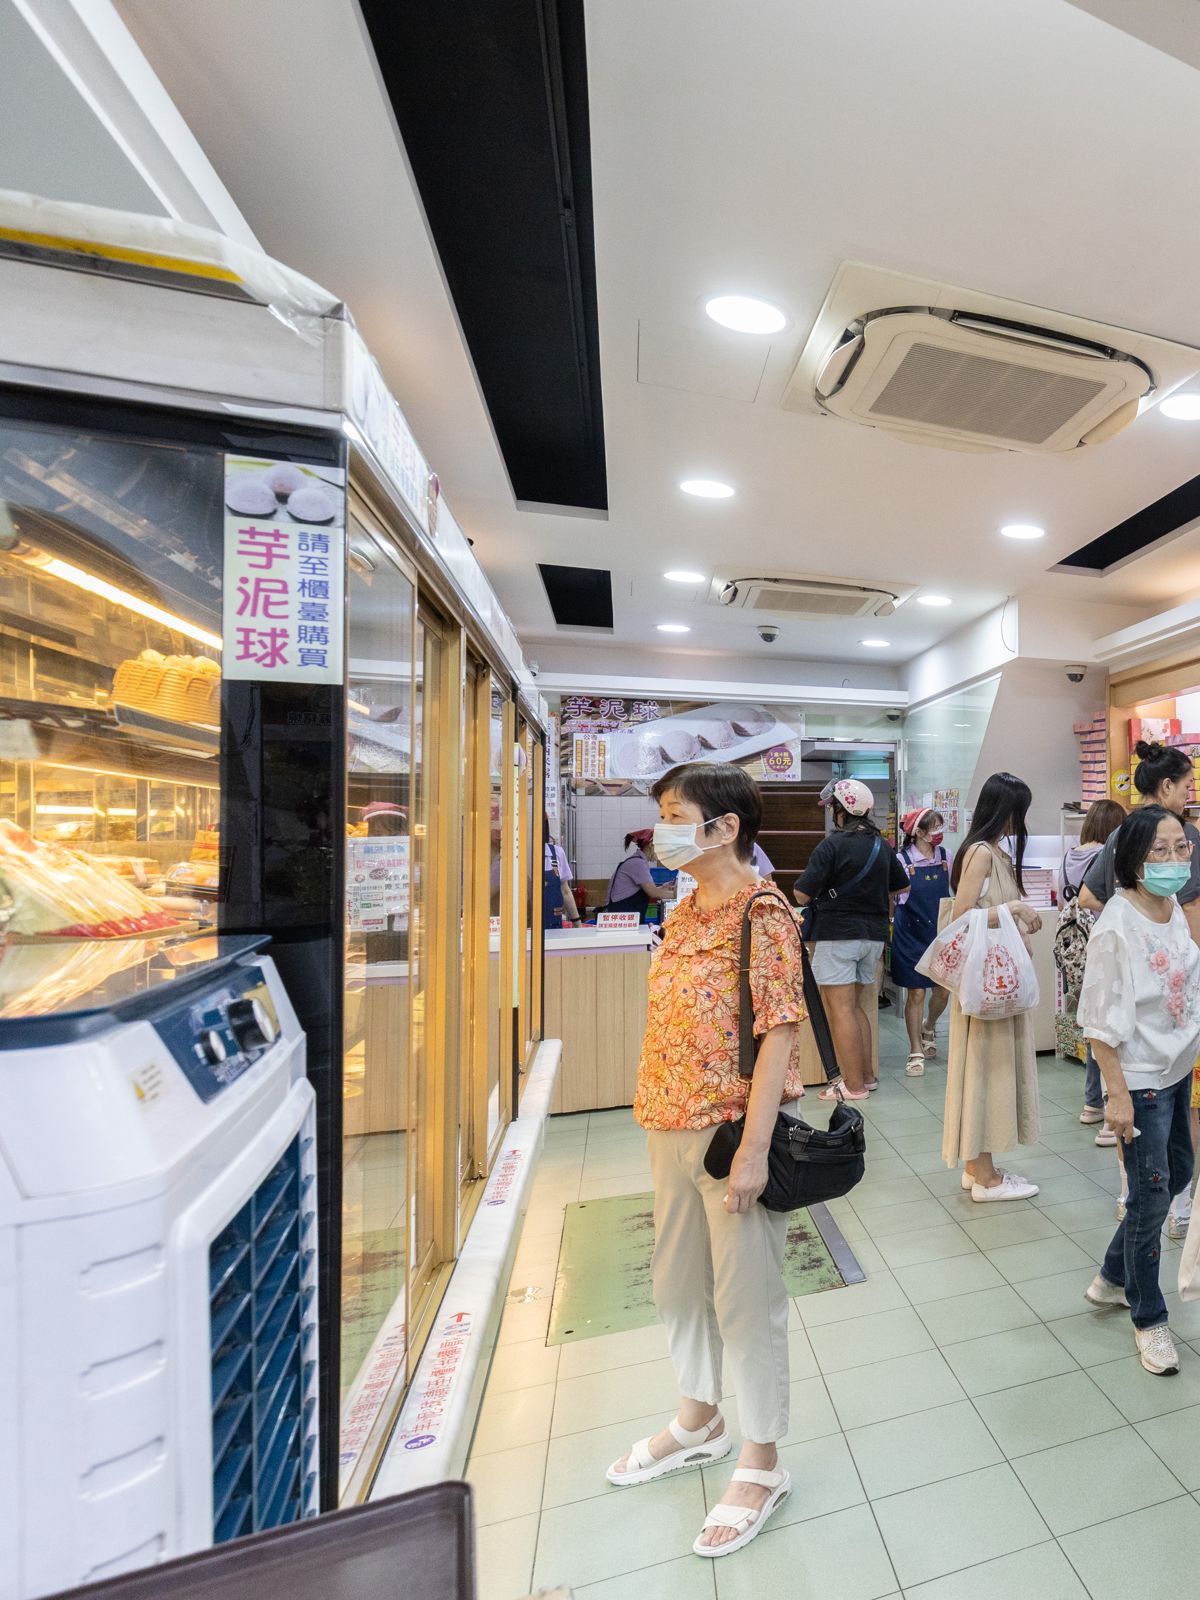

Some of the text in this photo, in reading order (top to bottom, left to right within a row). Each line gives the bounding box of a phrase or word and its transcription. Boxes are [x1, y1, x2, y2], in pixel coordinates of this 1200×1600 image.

[236, 526, 290, 668] 芋泥球
[297, 532, 330, 668] 請至櫃臺購買
[565, 697, 661, 720] 芋泥球
[769, 757, 791, 766] 60元
